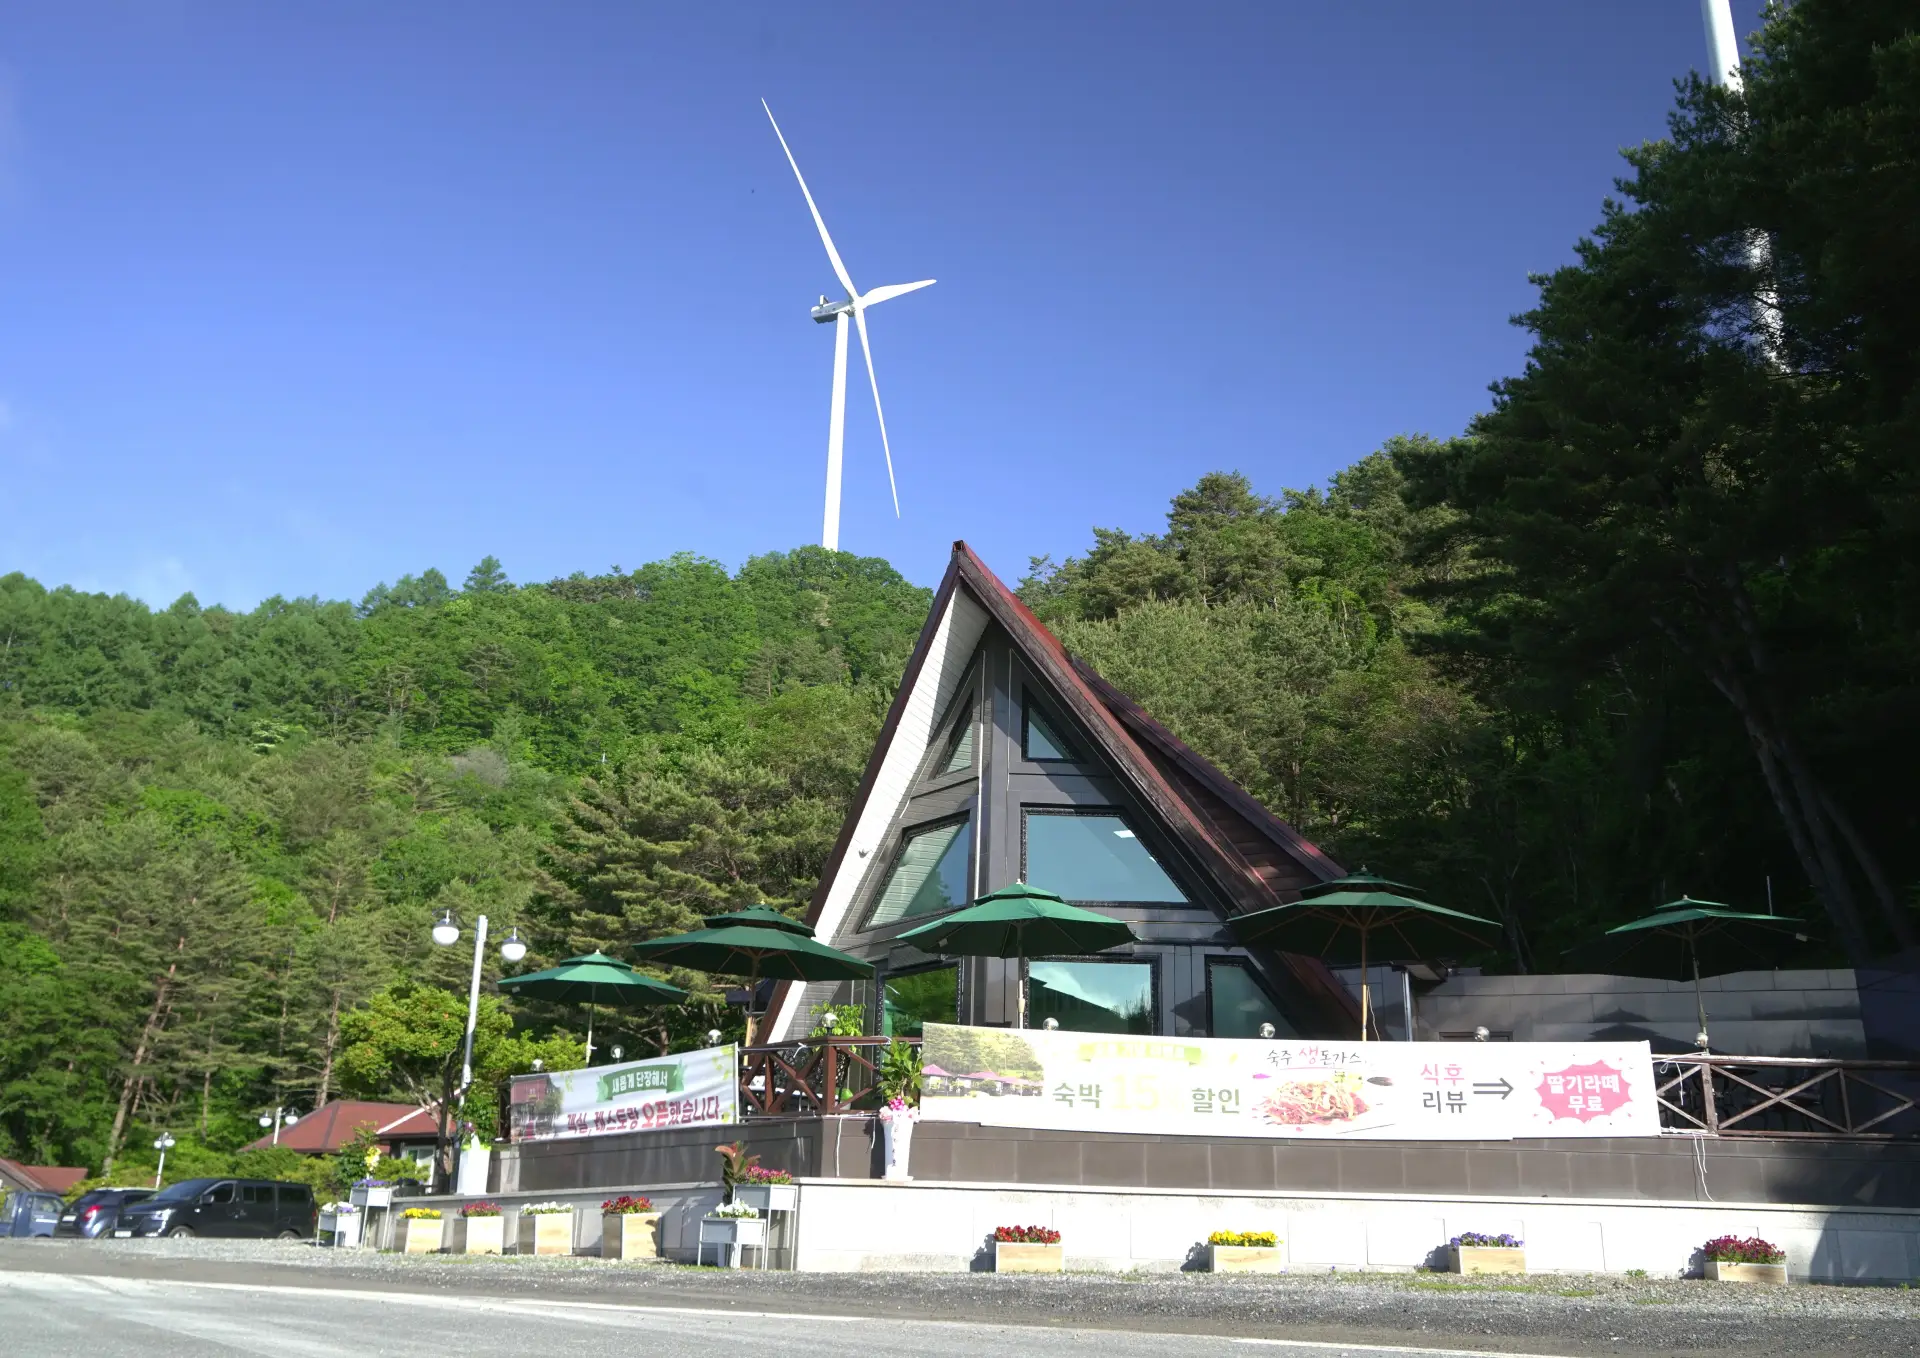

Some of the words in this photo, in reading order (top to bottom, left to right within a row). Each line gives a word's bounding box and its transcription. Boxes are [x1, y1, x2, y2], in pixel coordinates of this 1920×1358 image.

[1267, 1047, 1292, 1067] 숙주
[612, 1075, 635, 1093] 새롭게
[636, 1070, 668, 1088] 단장해서
[1420, 1063, 1465, 1086] 식후
[1547, 1074, 1620, 1095] 딸기라떼
[1052, 1082, 1102, 1109] 숙박
[1191, 1087, 1240, 1114] 할인
[1422, 1090, 1467, 1114] 리뷰
[1568, 1096, 1605, 1114] 무료
[593, 1107, 640, 1131] 레스토랑
